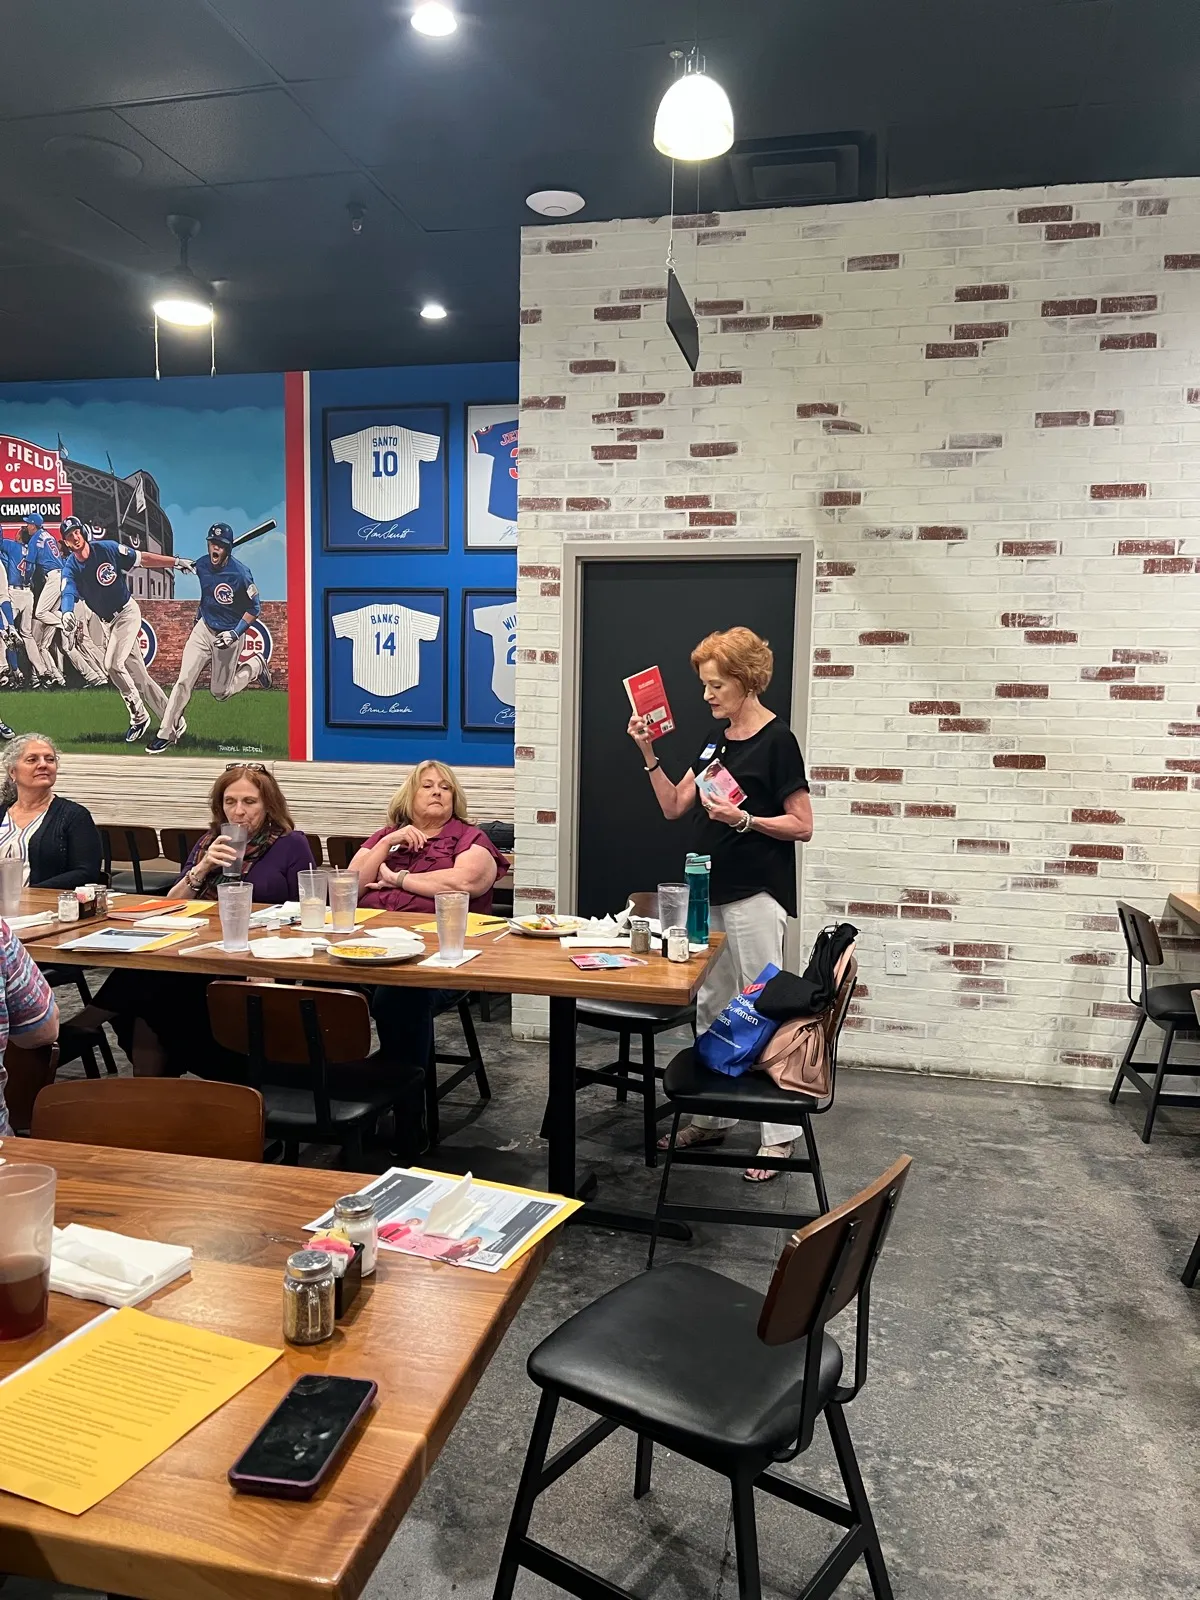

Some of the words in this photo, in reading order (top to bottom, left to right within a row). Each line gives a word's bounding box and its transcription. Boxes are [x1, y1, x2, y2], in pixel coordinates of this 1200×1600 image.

[372, 436, 398, 447] SANTO
[8, 442, 54, 471] FIELD
[5, 463, 21, 472] OF
[372, 450, 398, 478] 10
[10, 478, 56, 493] CUBS
[0, 503, 61, 516] CHAMPIONS
[370, 613, 400, 625] BANKS
[374, 631, 397, 657] 14
